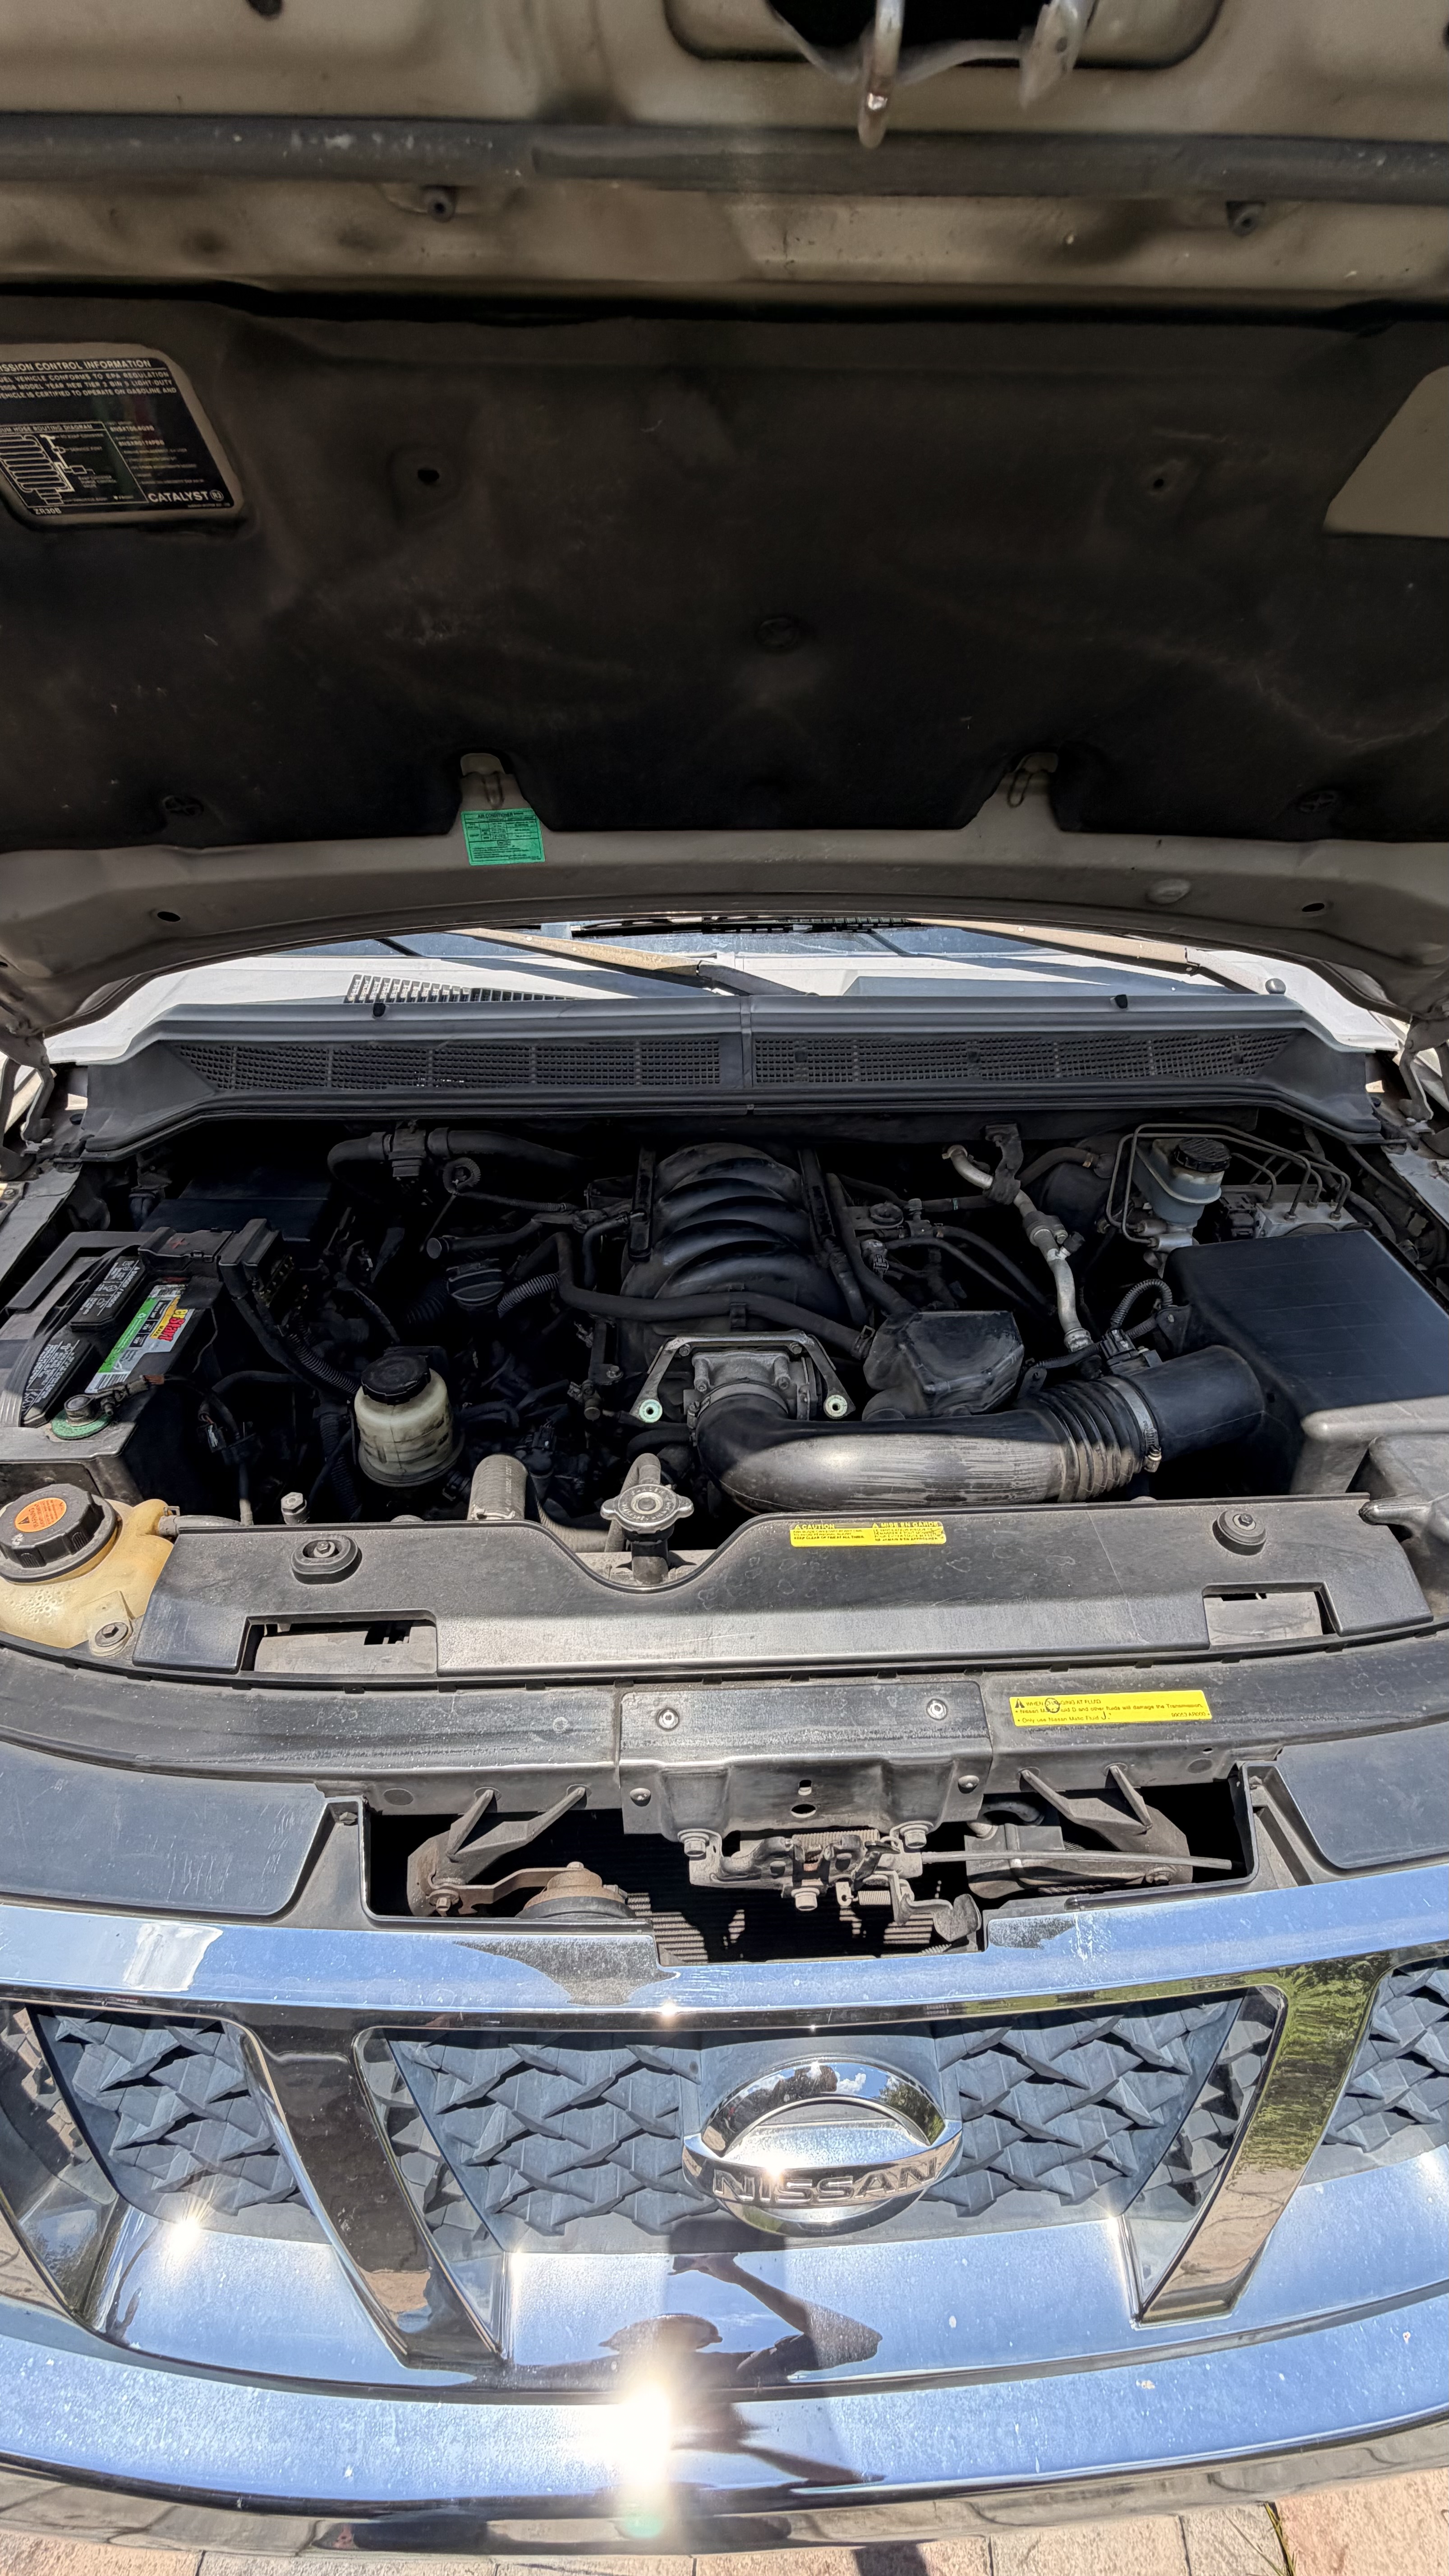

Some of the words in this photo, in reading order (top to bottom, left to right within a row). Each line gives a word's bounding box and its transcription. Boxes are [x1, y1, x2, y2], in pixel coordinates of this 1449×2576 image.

[0, 363, 34, 372] ISSION
[35, 361, 83, 371] CONTROL
[83, 359, 152, 369] INFORMATION
[148, 491, 209, 502] CATALYST
[158, 1309, 189, 1342] erStart
[713, 2157, 938, 2203] NISSAN
